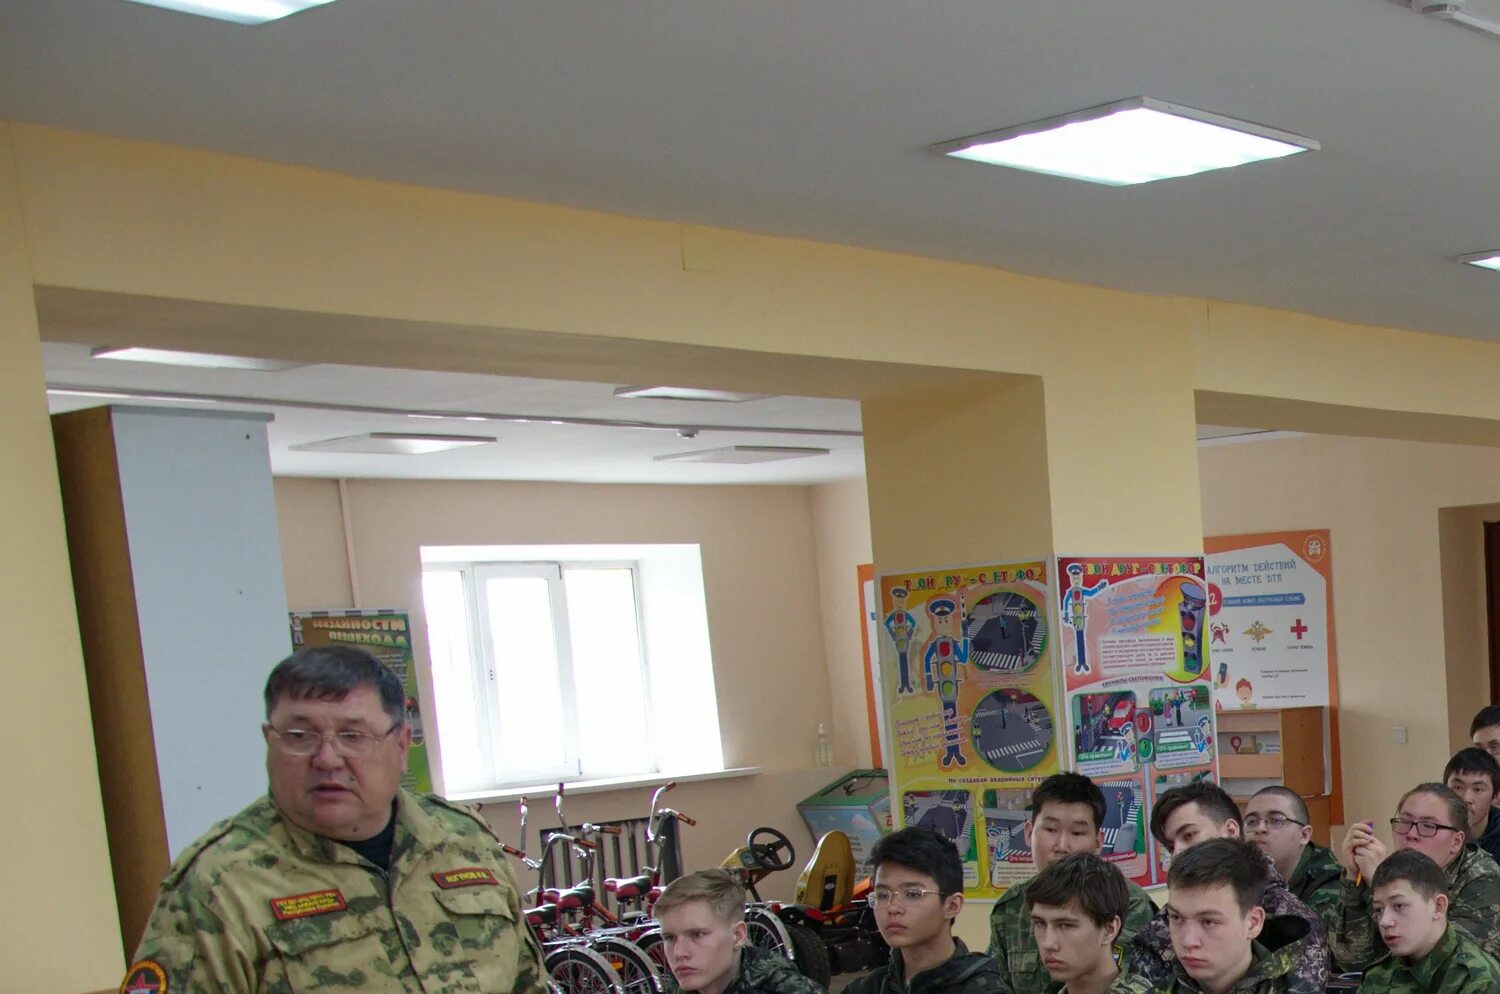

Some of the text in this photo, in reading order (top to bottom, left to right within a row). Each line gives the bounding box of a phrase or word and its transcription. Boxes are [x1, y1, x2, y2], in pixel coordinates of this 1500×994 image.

[1081, 562, 1108, 575] ТВОЙ
[1111, 563, 1139, 576] ДРУГ
[1149, 562, 1200, 575] СВЕТОФОР
[1253, 559, 1296, 571] ДЕЙСТВИЙ
[1221, 574, 1282, 585] НА МЕСТЕ ДТП
[328, 631, 409, 648] ПЕШЕХОДА
